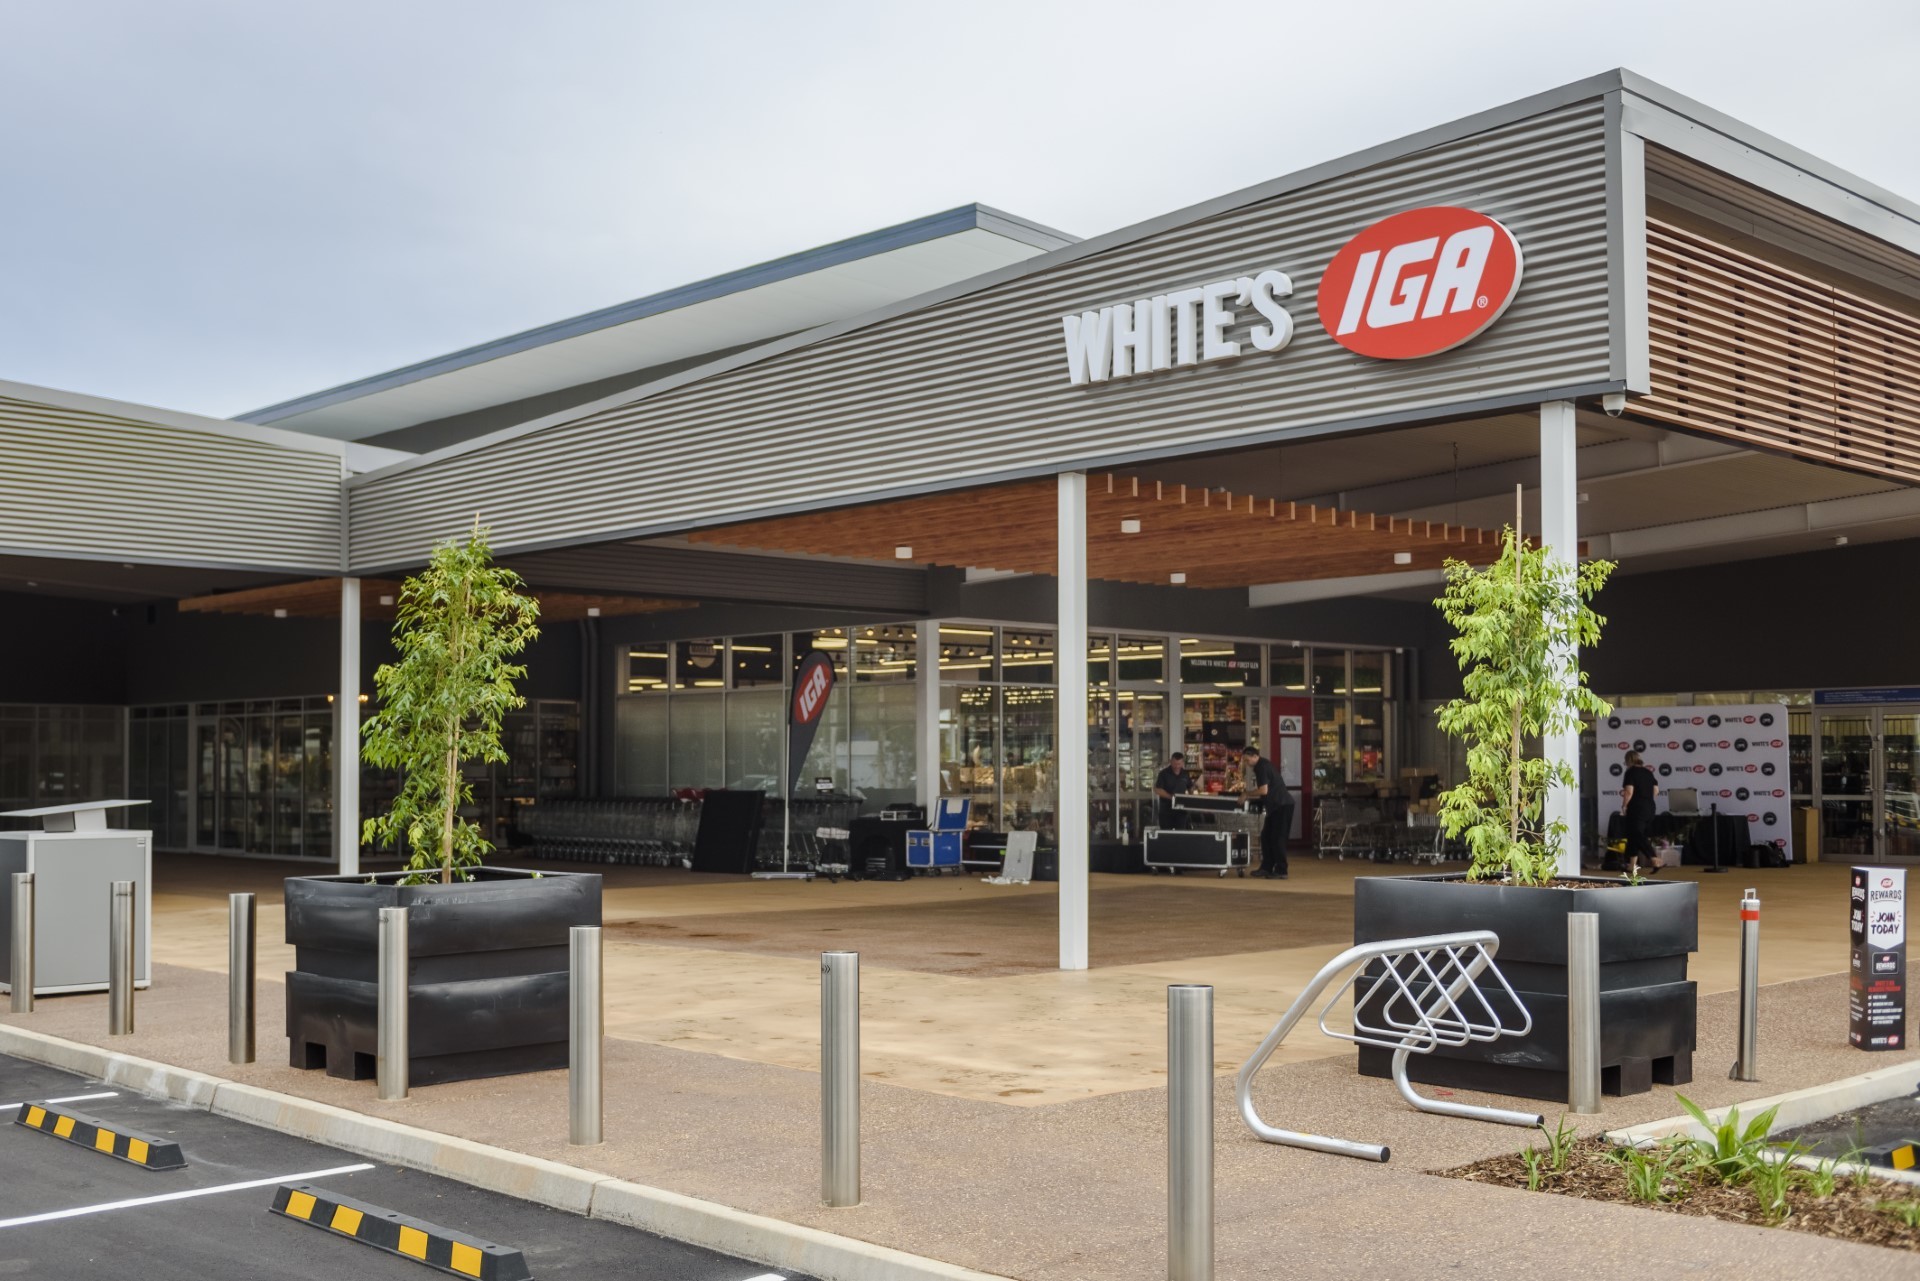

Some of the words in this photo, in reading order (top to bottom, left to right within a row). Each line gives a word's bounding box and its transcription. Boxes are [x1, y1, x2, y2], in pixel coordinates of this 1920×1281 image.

[1062, 270, 1293, 385] WHITE'S
[1337, 225, 1495, 336] IGA
[1316, 676, 1321, 684] 2
[799, 664, 826, 721] IGA
[1871, 890, 1901, 901] REWARDS
[1876, 912, 1896, 923] JOIN
[1871, 923, 1899, 935] TODAY
